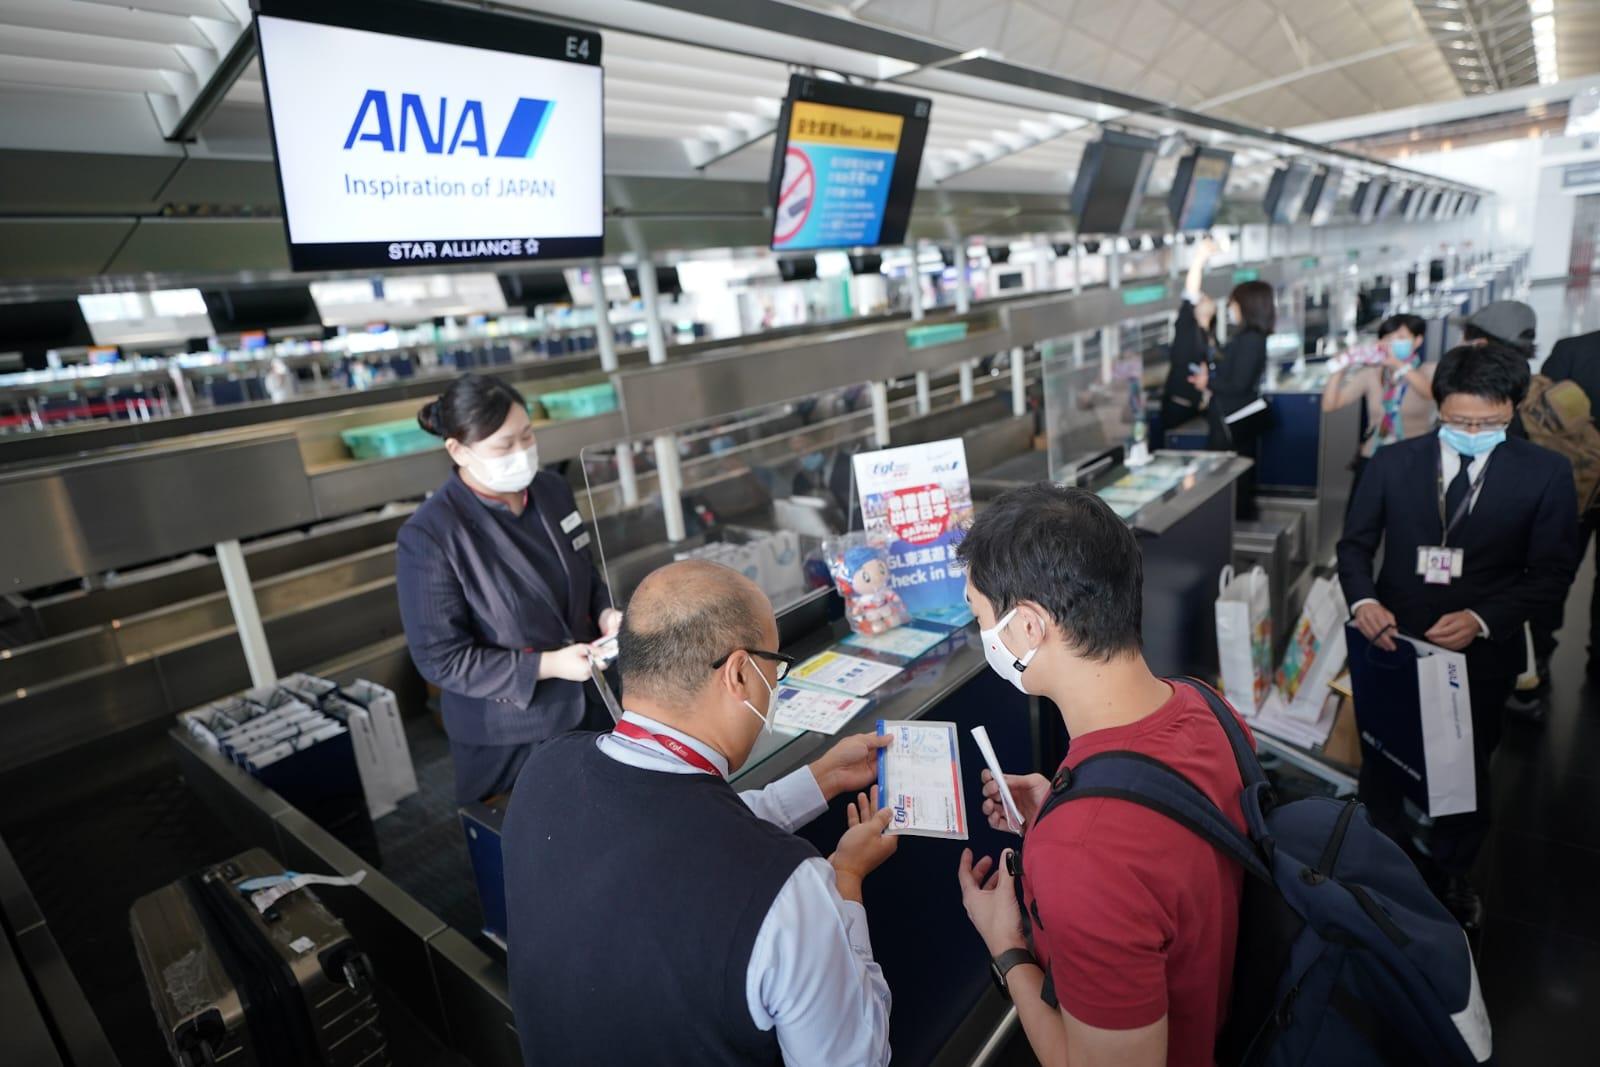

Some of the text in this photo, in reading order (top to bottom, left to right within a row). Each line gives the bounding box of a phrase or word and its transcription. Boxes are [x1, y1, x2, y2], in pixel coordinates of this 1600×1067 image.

[565, 37, 590, 60] E4
[343, 89, 489, 158] ANA
[345, 173, 555, 199] Inspiration of JAPAN
[388, 239, 522, 260] STAR ALLIANCE
[930, 565, 946, 582] in
